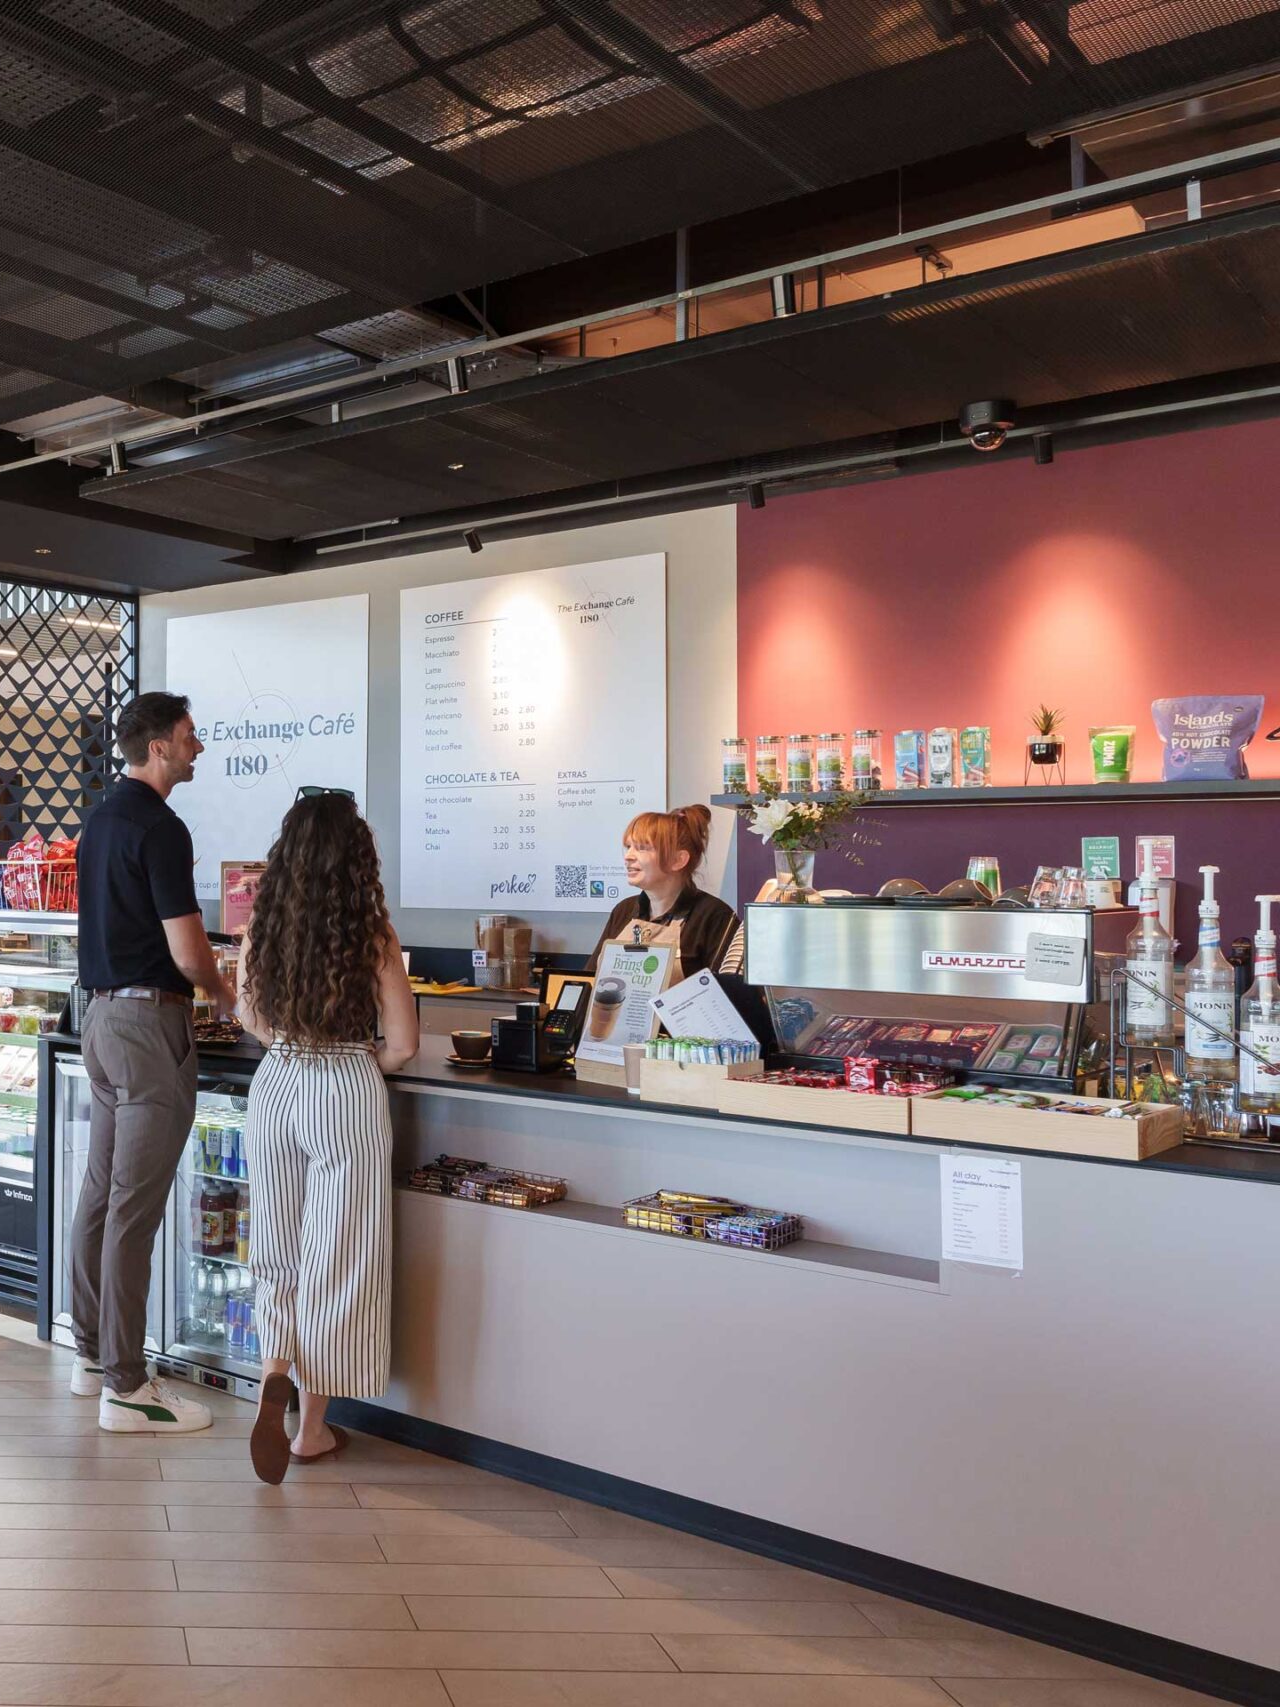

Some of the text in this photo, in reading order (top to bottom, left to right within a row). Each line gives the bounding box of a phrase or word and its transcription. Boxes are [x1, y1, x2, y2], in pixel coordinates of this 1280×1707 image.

[558, 596, 635, 613] The Exchange Café
[425, 610, 464, 624] COFFEE
[425, 636, 454, 644] Espresso
[425, 650, 460, 659] Macchiato
[425, 680, 466, 690] Cappuccino
[425, 712, 462, 720] Americano
[1174, 710, 1234, 730] Islands
[212, 720, 304, 744] Exchange
[308, 712, 355, 736] Café
[425, 728, 448, 736] Mocha
[425, 742, 462, 752] Iced coffee
[1171, 736, 1231, 750] POWDER
[1103, 740, 1116, 768] ZUMA
[225, 754, 268, 775] 1180
[425, 772, 520, 784] CHOCOLATE & TEA
[558, 770, 587, 779] EXTRAS
[558, 788, 579, 796] Coffee
[620, 786, 634, 794] 0.90
[438, 796, 472, 804] chocolate
[558, 800, 576, 808] Syrup
[425, 812, 437, 820] Tea
[519, 810, 535, 818] 2.20
[493, 826, 535, 834] 3.20 3.55
[493, 842, 535, 850] 3.20 3.55
[490, 874, 532, 898] perkee
[613, 957, 643, 973] Bring
[632, 974, 652, 988] cup
[1194, 1002, 1232, 1010] MONIN
[964, 1172, 981, 1182] day
